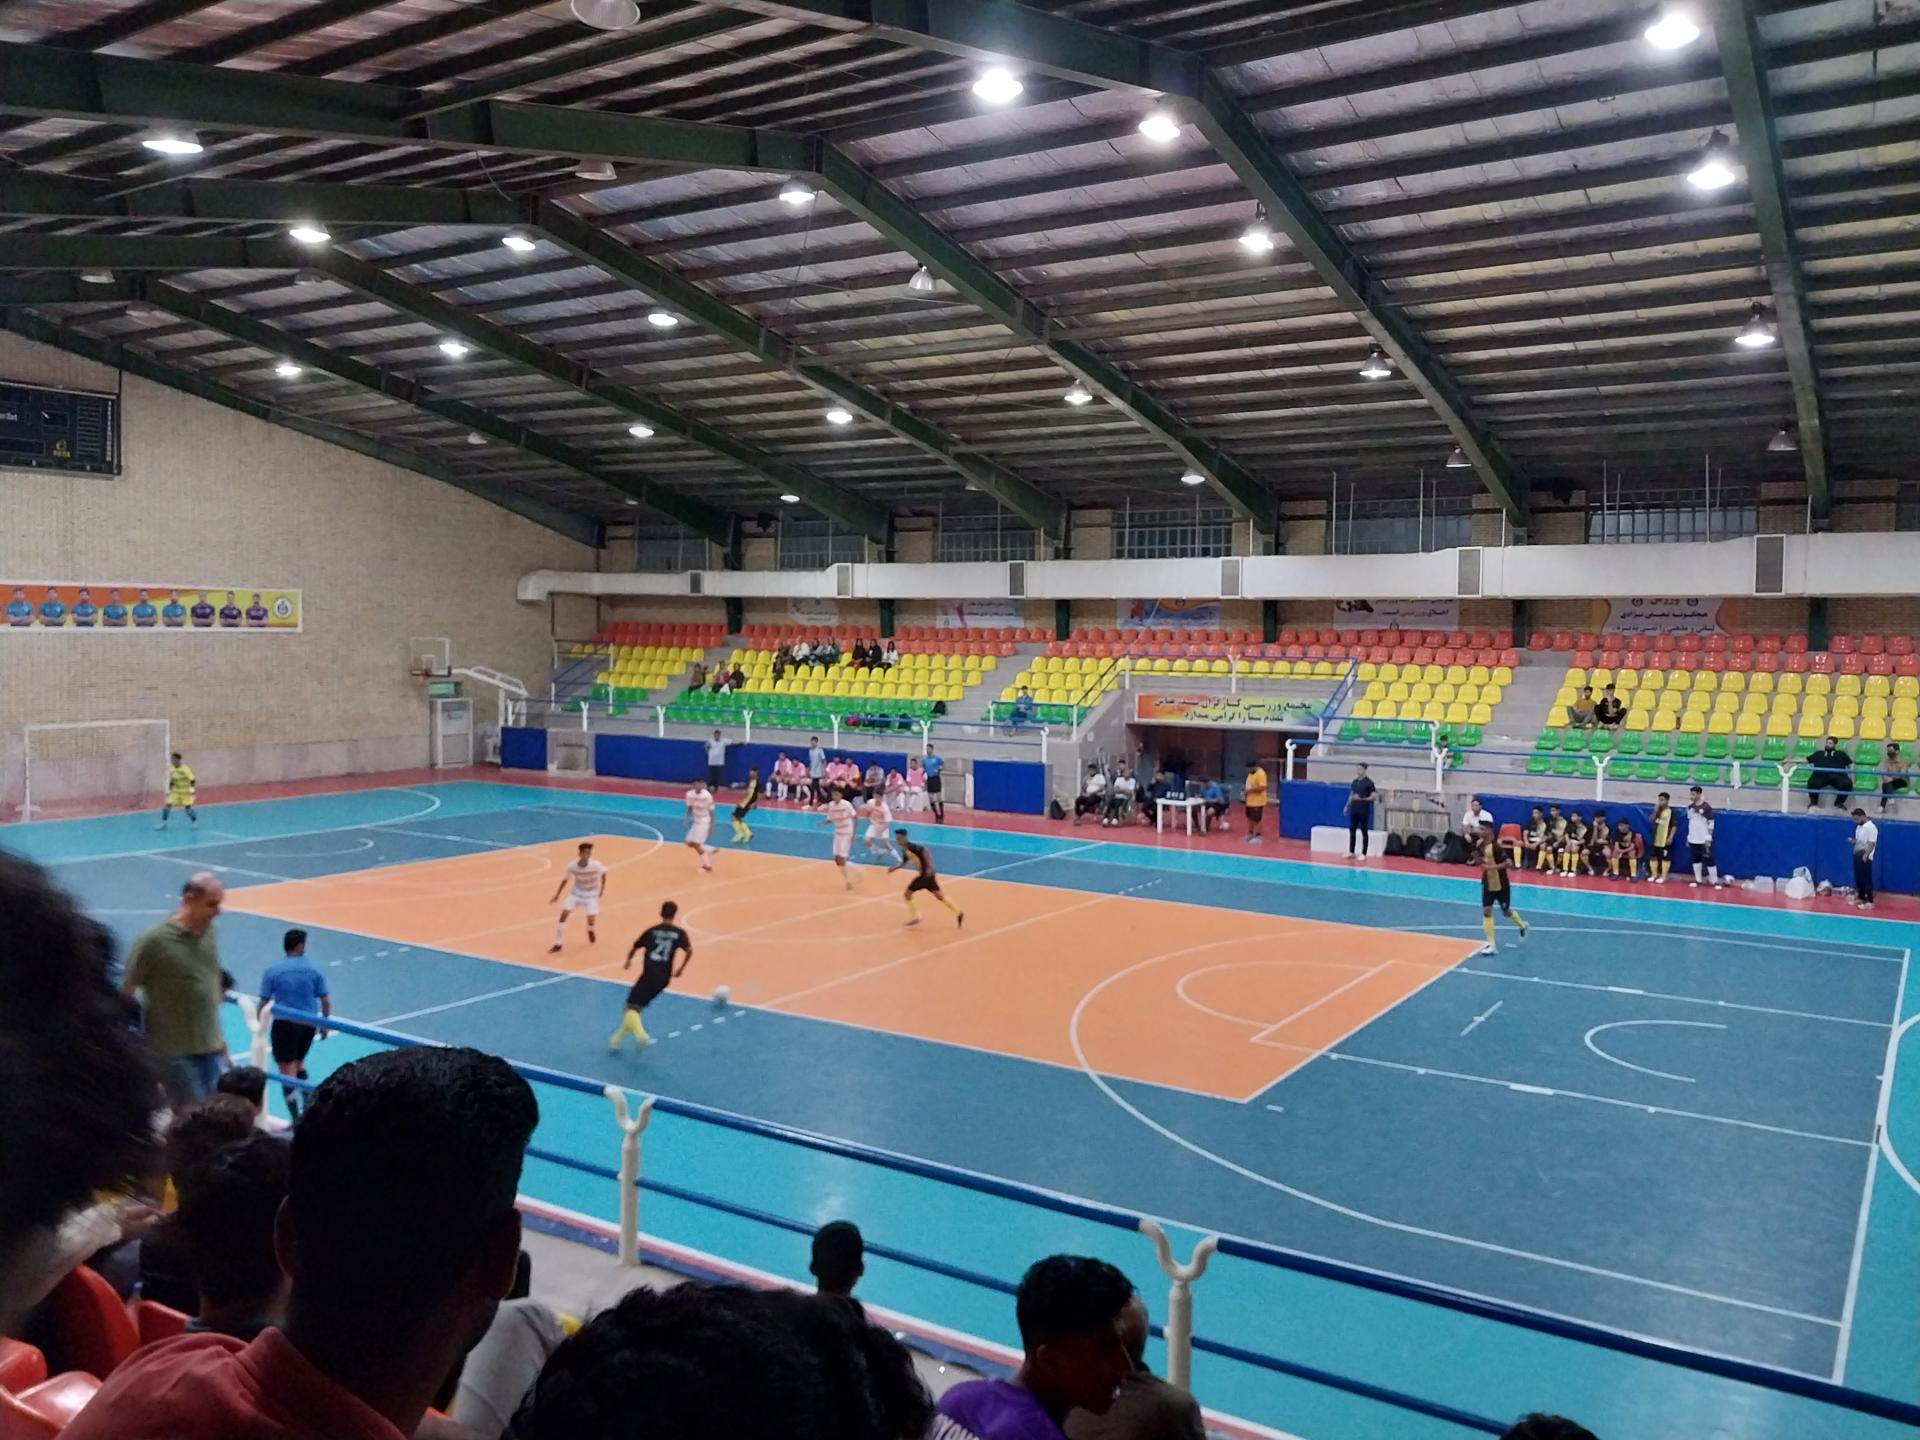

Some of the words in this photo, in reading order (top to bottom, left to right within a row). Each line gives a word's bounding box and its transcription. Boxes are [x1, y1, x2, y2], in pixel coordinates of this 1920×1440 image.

[1200, 697, 1242, 712] کارگران
[1243, 698, 1282, 712] ورزشی
[1284, 700, 1311, 712] مجتمع
[1211, 711, 1236, 722] گرامی
[1238, 711, 1246, 723] را
[1248, 711, 1262, 721] شما
[1264, 714, 1283, 723] مقدم
[650, 939, 672, 961] 21
